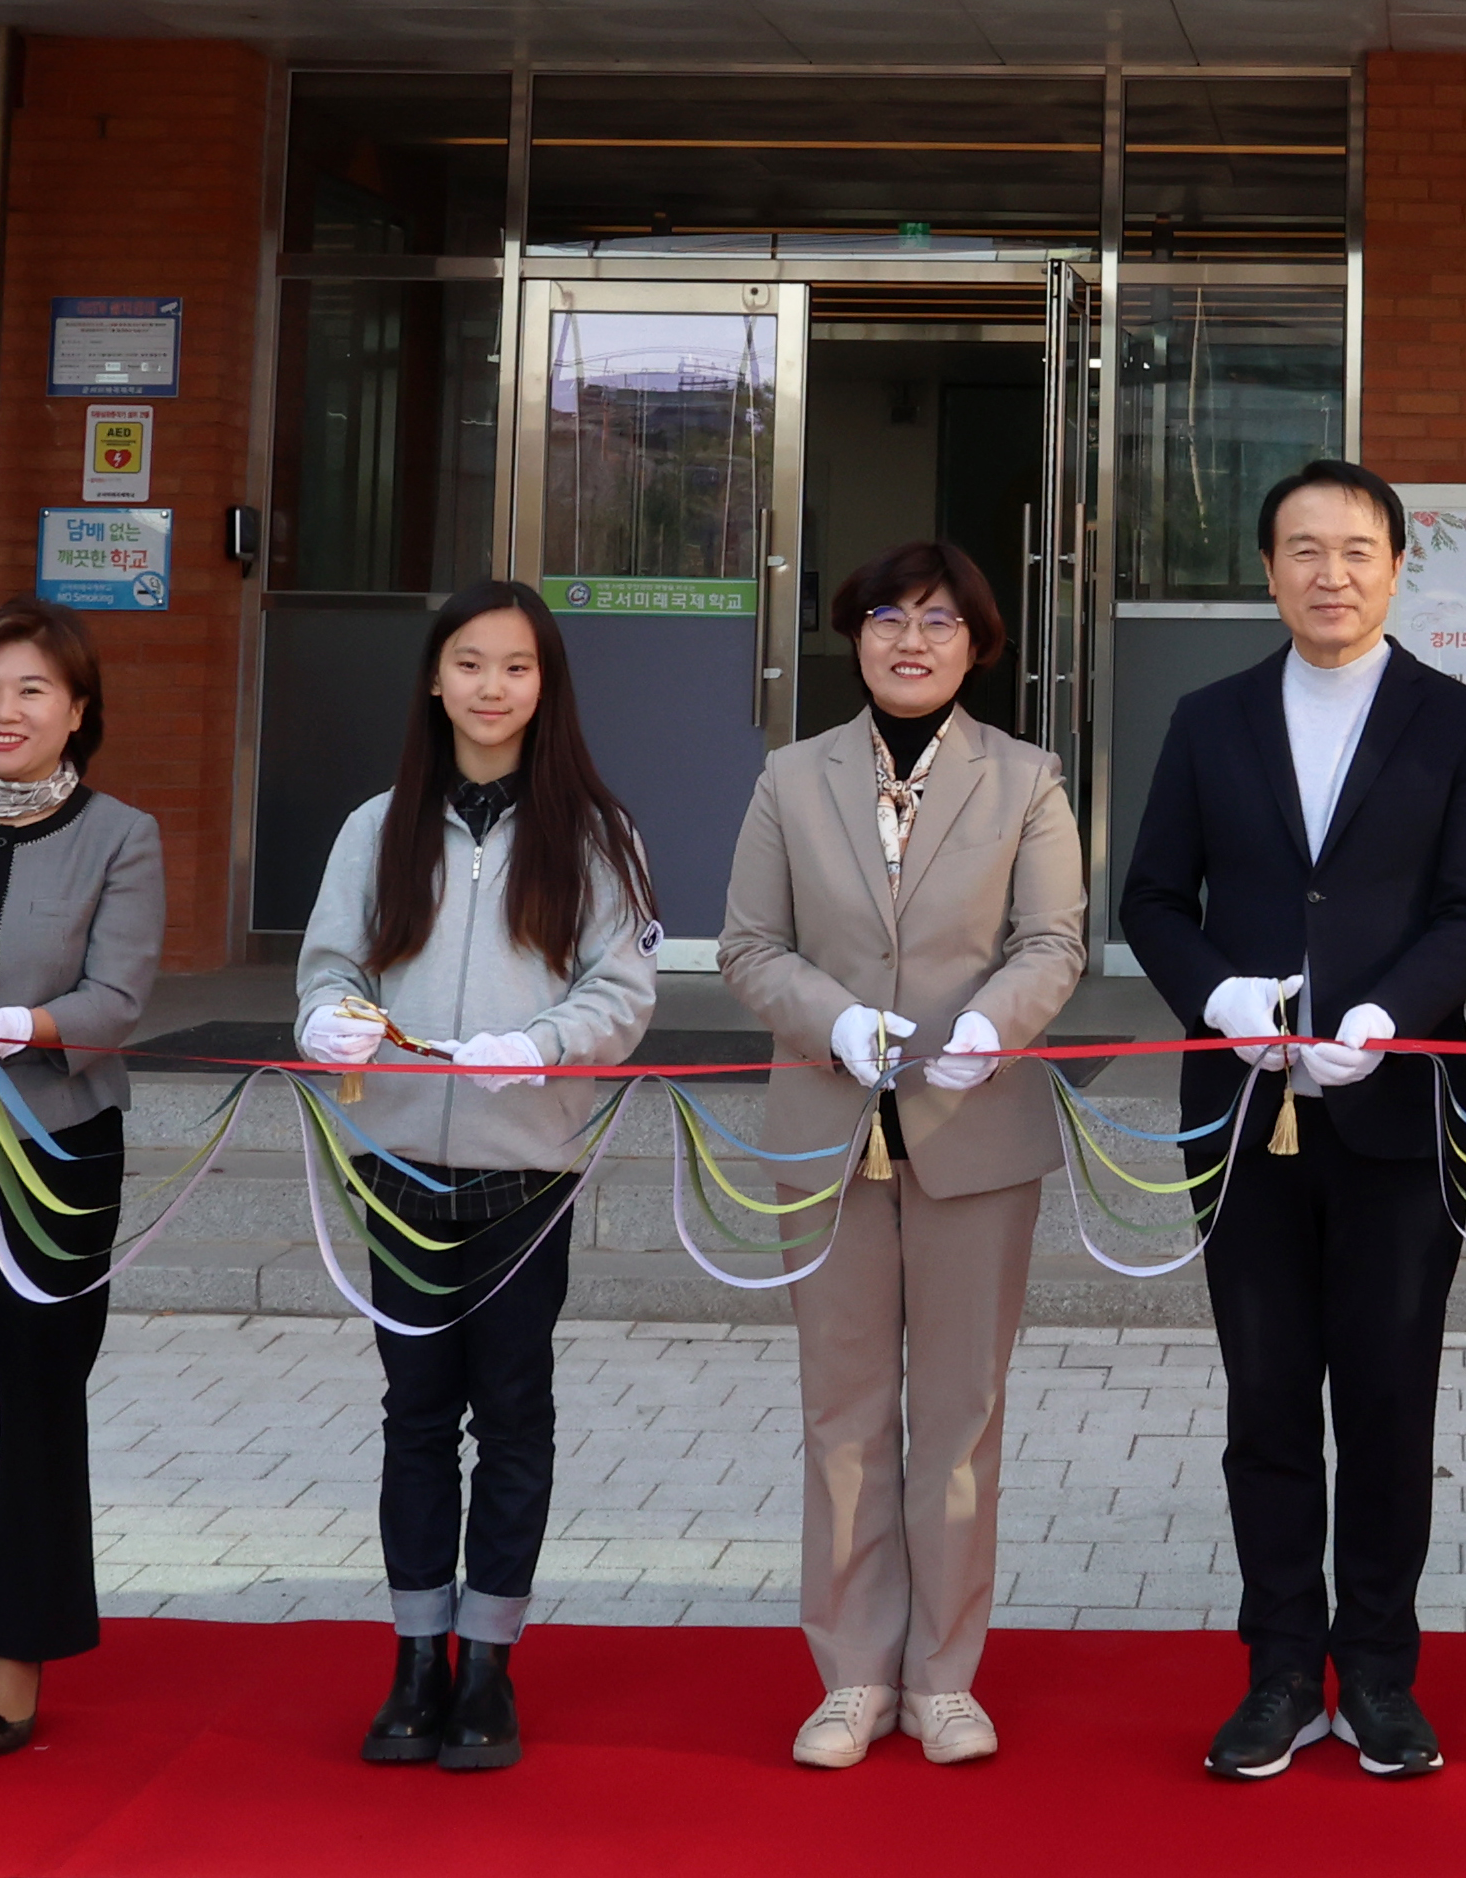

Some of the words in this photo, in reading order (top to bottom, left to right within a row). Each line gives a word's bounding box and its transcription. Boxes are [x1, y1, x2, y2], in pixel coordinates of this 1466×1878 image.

[107, 427, 132, 438] AED
[67, 519, 104, 542] 담배
[109, 523, 141, 542] 없는
[57, 549, 106, 569] 깨끗한
[110, 548, 149, 572] 학교
[597, 591, 742, 610] 군서미래국제학교
